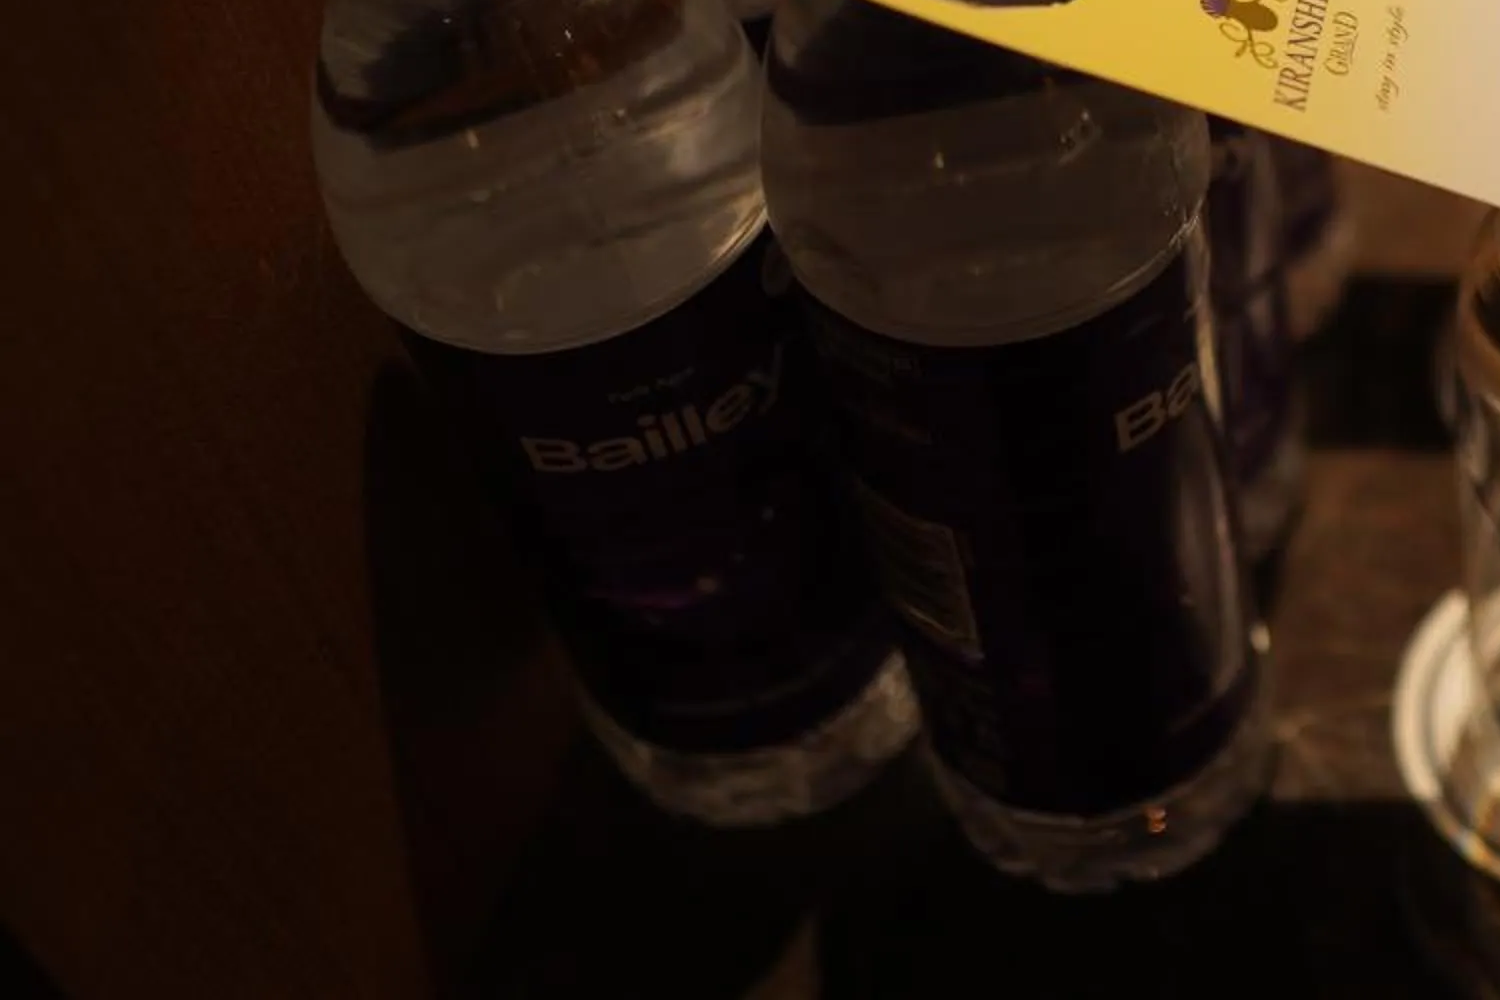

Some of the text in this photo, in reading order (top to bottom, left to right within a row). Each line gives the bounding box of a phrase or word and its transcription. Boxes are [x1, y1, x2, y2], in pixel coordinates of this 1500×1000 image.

[1323, 10, 1359, 76] GRAND
[1375, 7, 1409, 111] stay in style
[519, 336, 792, 473] Bailley
